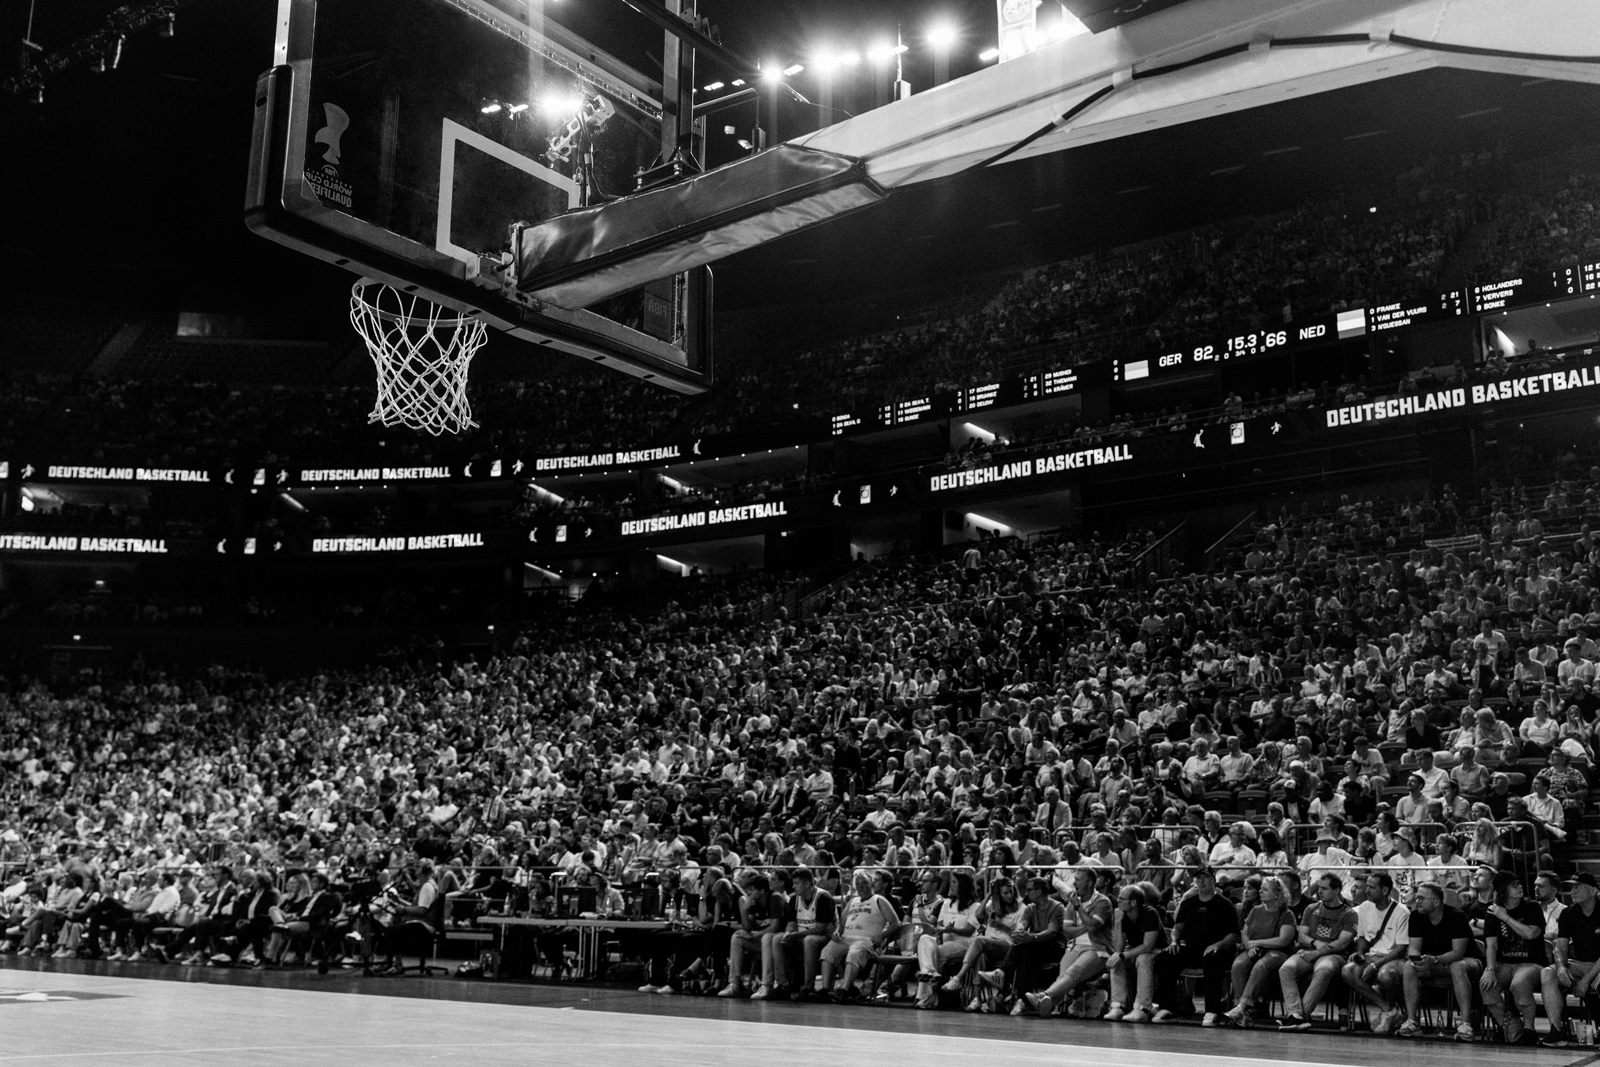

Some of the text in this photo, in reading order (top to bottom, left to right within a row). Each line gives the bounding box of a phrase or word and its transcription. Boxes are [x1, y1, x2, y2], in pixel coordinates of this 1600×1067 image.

[1584, 264, 1593, 272] 12
[1482, 279, 1522, 292] HOLLANDERS
[1483, 289, 1513, 301] VERVERS
[1376, 303, 1400, 313] FRANKE
[1484, 300, 1505, 310] BONKE
[1392, 311, 1405, 319] DER
[1159, 325, 1325, 367] GER 82 15.3 66 NED
[1327, 366, 1600, 427] DEUTSCHLAND BASKETBALL
[536, 445, 680, 470] DEUTSCHLAND BASKETBALL
[48, 466, 210, 482] DEUTSCHLAND BASKETBALL
[301, 467, 451, 481] DEUTSCHLAND BASKETBALL
[931, 444, 1133, 491] DEUTSCHLAND BASKETBALL
[622, 501, 787, 535] DEUTSCHLAND BASKETBALL
[80, 538, 168, 553] BASKETBALL
[313, 533, 484, 552] DEUTSCHLAND BASKETBALL
